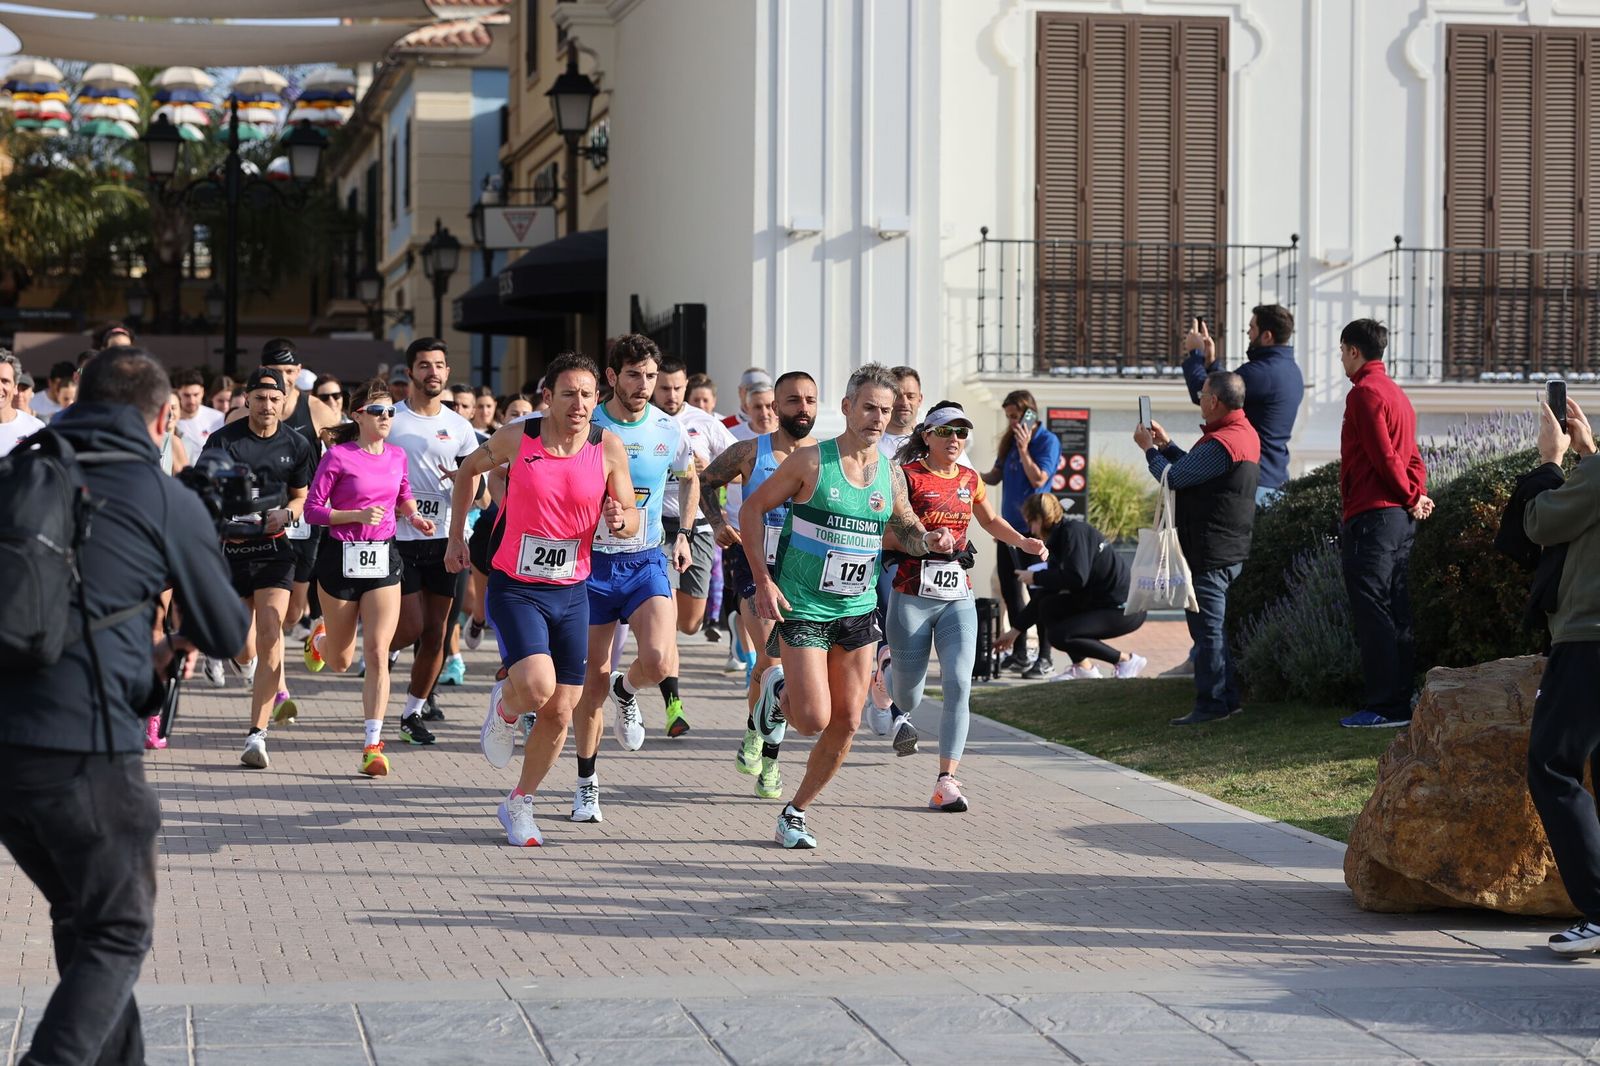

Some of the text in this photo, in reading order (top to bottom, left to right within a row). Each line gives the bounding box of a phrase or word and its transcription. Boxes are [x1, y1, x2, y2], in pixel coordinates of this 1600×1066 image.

[416, 500, 439, 516] 284
[827, 514, 878, 533] ATLETISMO
[359, 550, 377, 566] 84
[533, 546, 567, 567] 240
[840, 562, 867, 582] 179
[933, 570, 959, 588] 425
